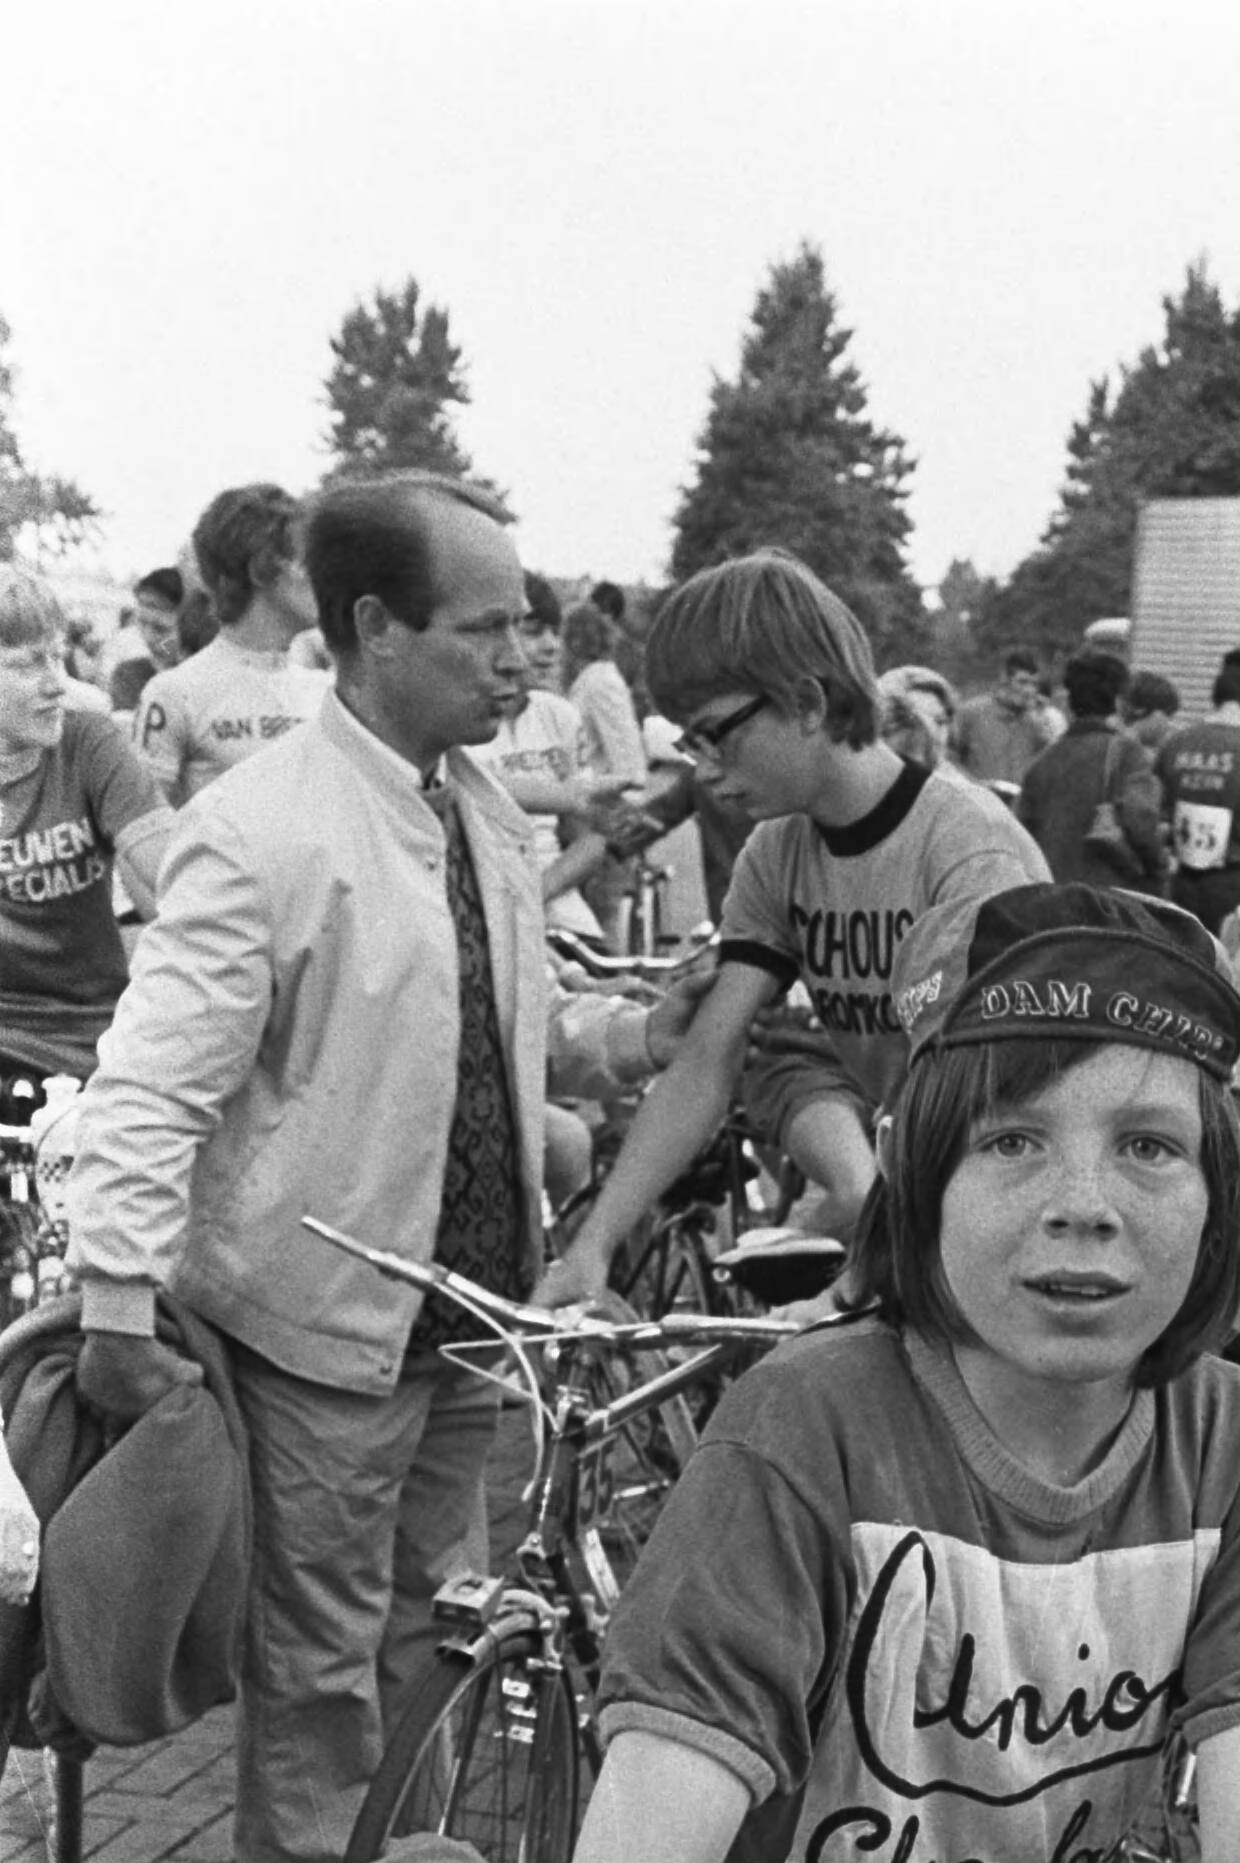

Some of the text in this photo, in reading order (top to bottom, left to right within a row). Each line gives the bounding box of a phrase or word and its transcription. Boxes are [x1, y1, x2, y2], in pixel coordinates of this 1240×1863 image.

[211, 719, 253, 741] VAN
[980, 979, 1093, 1020] DAM
[847, 1530, 1186, 1807] Unio
